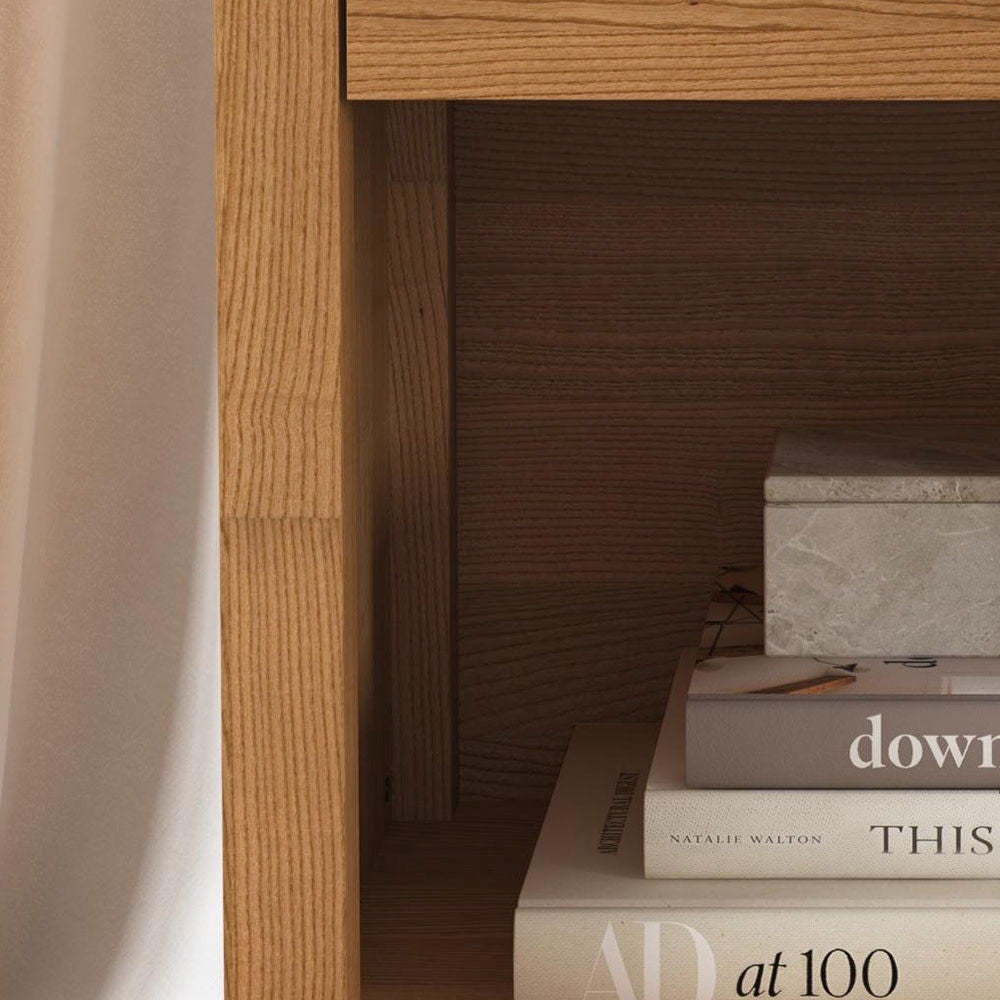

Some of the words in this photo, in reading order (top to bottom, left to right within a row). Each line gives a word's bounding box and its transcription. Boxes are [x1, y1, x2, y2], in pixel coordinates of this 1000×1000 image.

[670, 834, 742, 844] NATALIE
[750, 835, 822, 845] WALTON
[870, 825, 995, 855] THIS
[583, 920, 717, 1000] AD
[736, 951, 787, 997] at
[800, 948, 899, 998] 100
